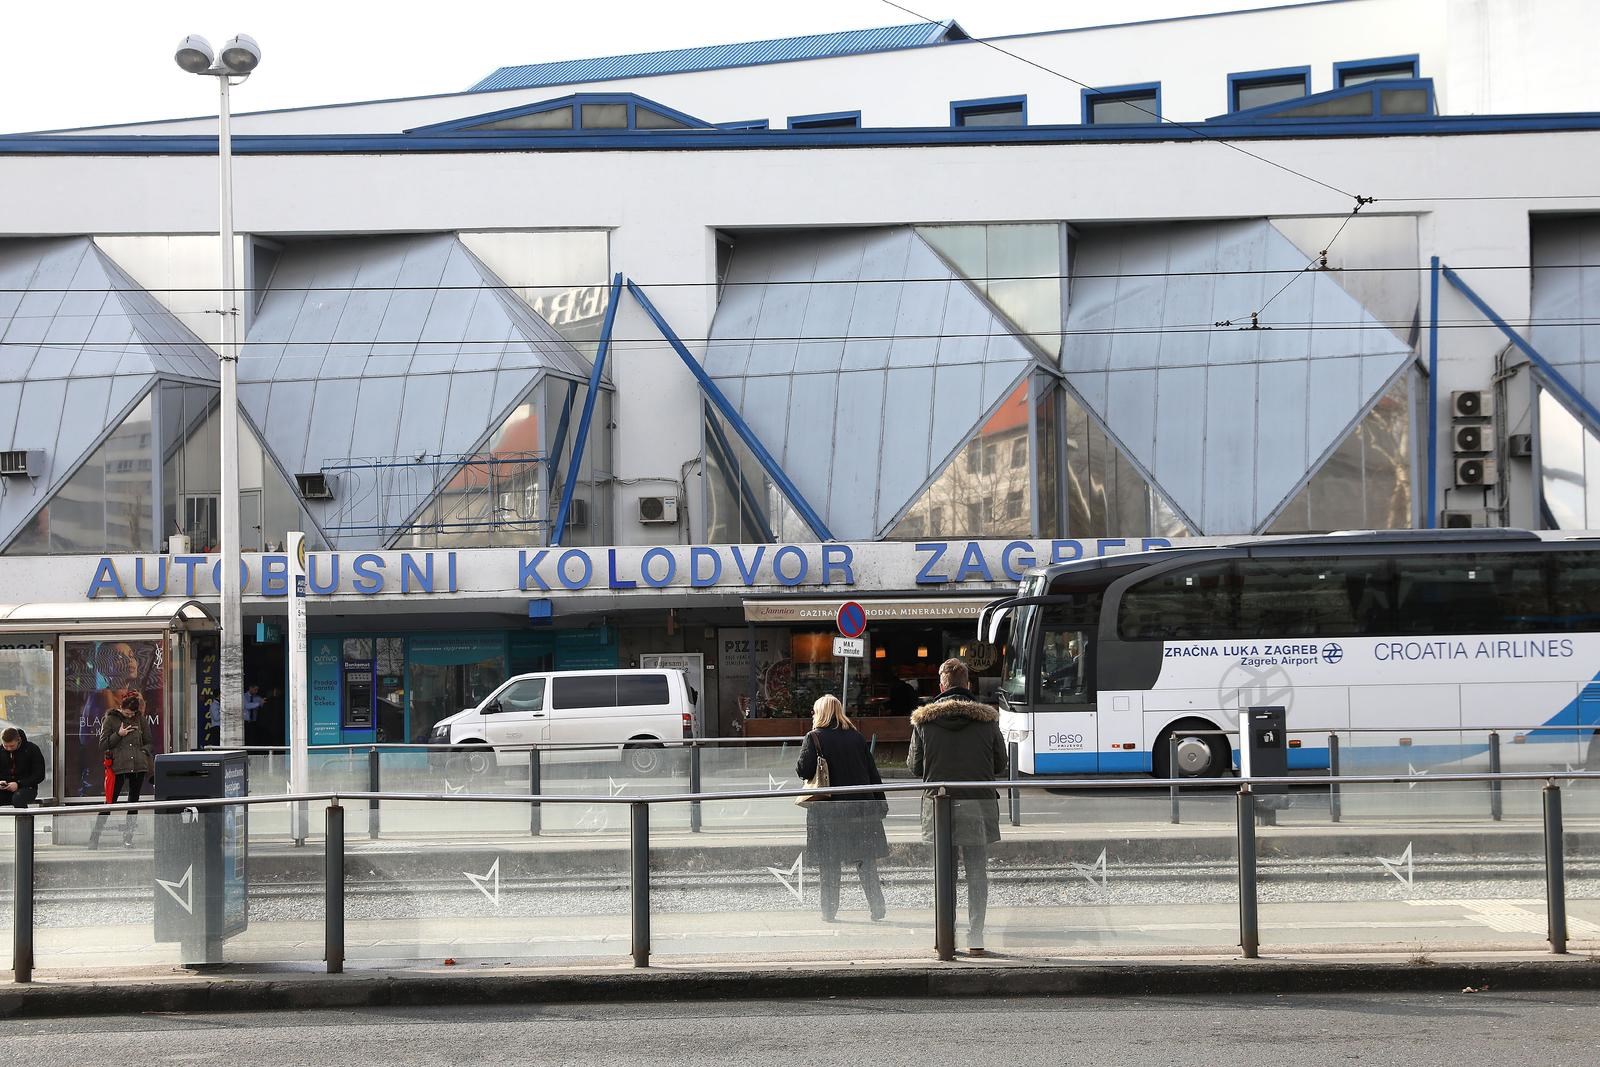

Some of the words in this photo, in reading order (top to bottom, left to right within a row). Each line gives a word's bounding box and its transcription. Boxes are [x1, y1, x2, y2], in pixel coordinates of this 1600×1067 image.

[518, 544, 855, 591] KOLODVOR
[914, 537, 1172, 584] ZAGR
[865, 609, 897, 617] RODNA
[900, 607, 954, 616] MINERALNA
[957, 606, 983, 614] VODA
[1165, 645, 1218, 657] ZRAČNA
[1223, 646, 1259, 656] LUKA
[1264, 644, 1318, 655] ZAGREB
[1374, 642, 1468, 661] CROATIA
[1475, 639, 1573, 659] AIRLINES
[1241, 657, 1278, 668] Zagreb
[1281, 656, 1318, 667] Airport
[79, 716, 104, 728] BLA
[1048, 731, 1083, 747] pleso
